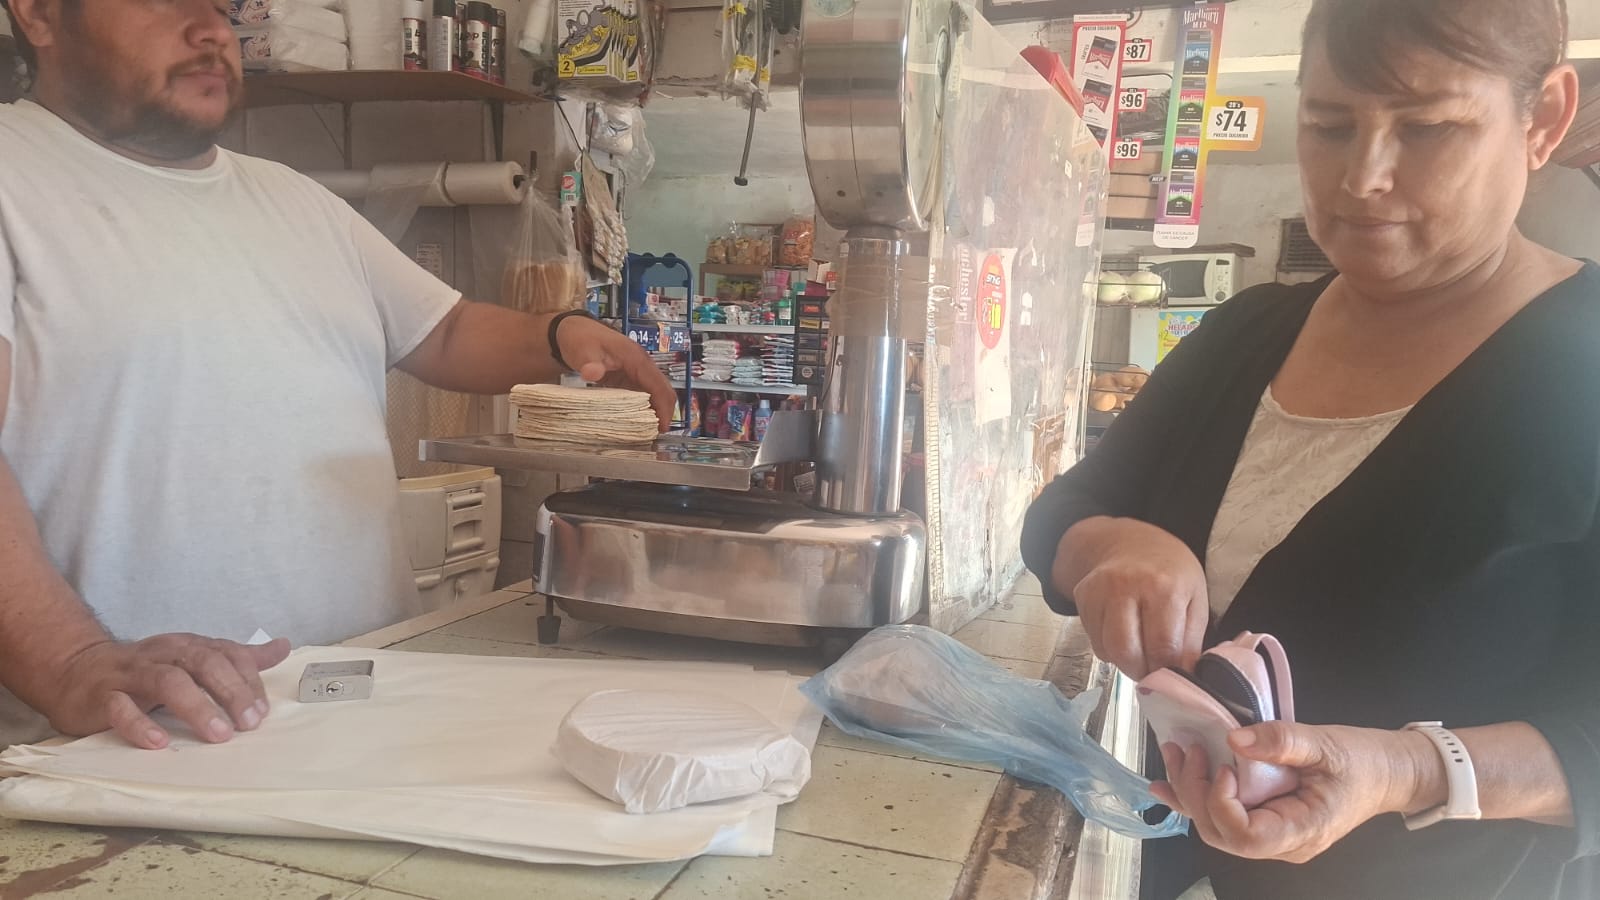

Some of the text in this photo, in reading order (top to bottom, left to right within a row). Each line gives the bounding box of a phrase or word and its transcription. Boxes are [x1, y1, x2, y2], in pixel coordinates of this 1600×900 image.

[1183, 8, 1219, 25] Marlboro
[1192, 21, 1207, 29] MIX
[1126, 44, 1146, 59] $87
[563, 60, 571, 71] 2
[1121, 93, 1143, 108] $96
[1215, 110, 1247, 132] $74
[1116, 143, 1138, 157] $96
